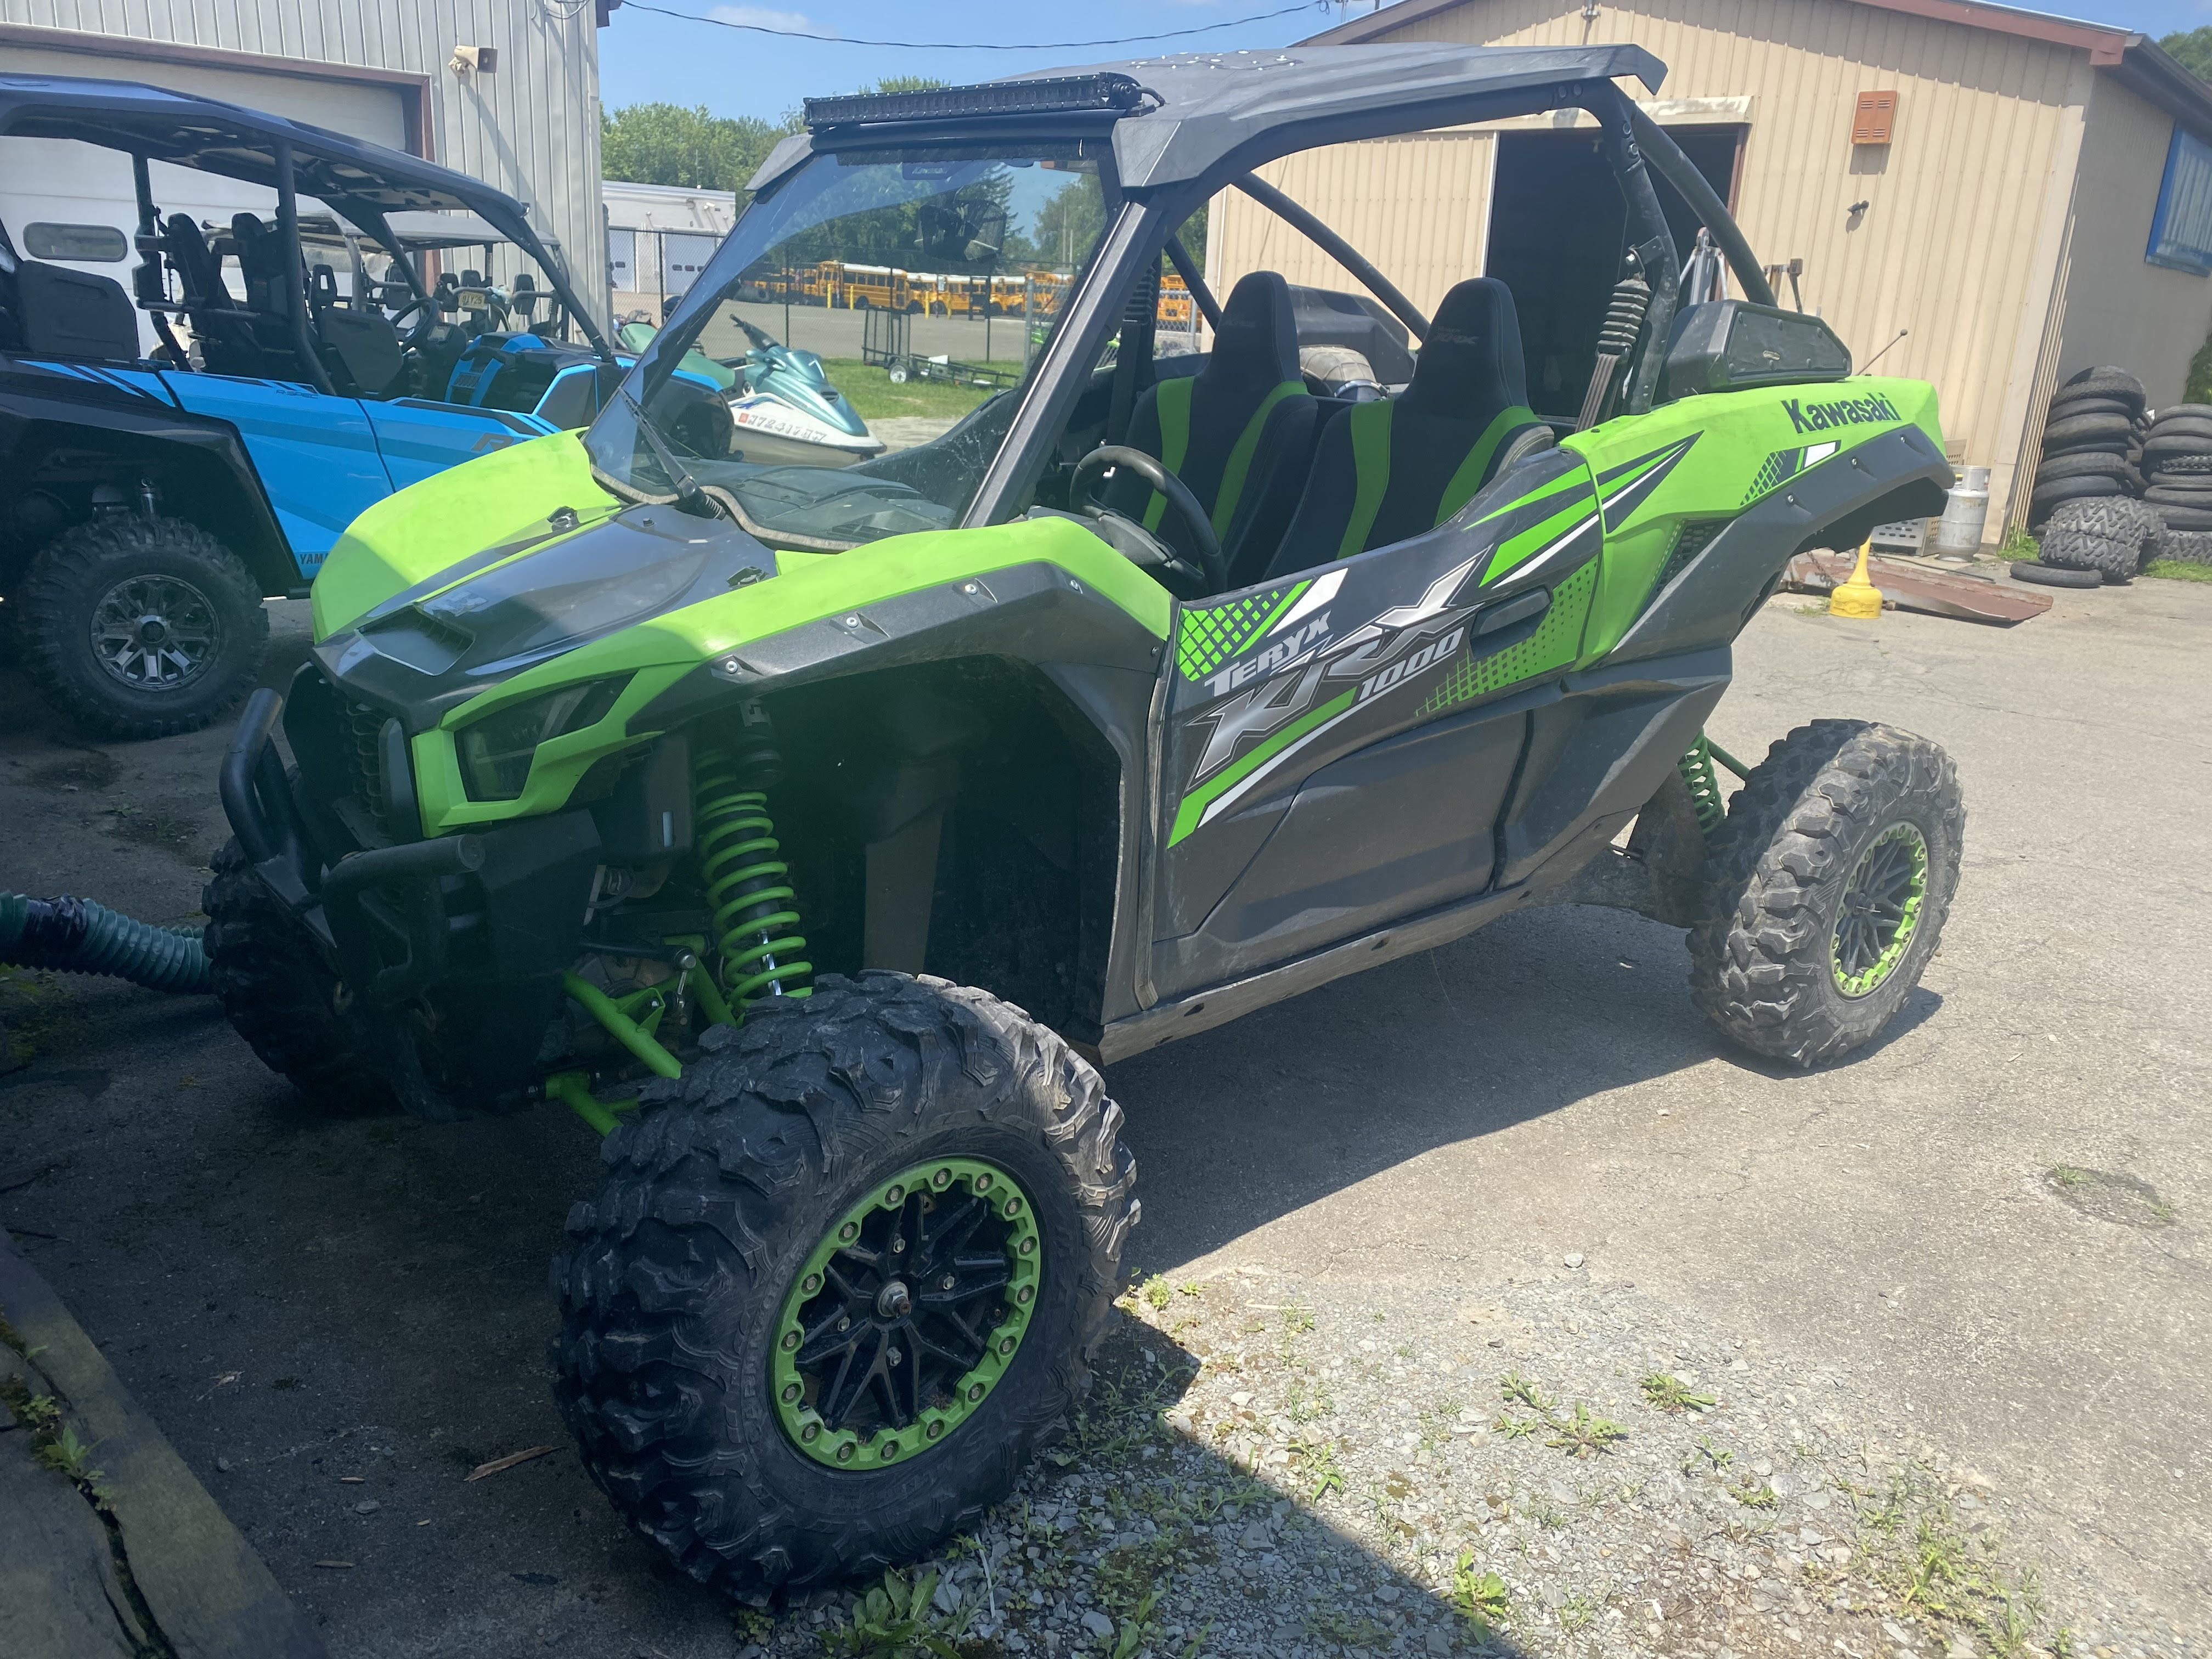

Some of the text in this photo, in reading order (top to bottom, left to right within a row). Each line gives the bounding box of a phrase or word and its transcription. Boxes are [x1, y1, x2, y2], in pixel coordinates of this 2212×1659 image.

[1781, 392, 1902, 433] Kawasaki
[1186, 546, 1490, 789] KRX
[1204, 610, 1333, 697] TERYX
[1358, 626, 1465, 702] 1000
